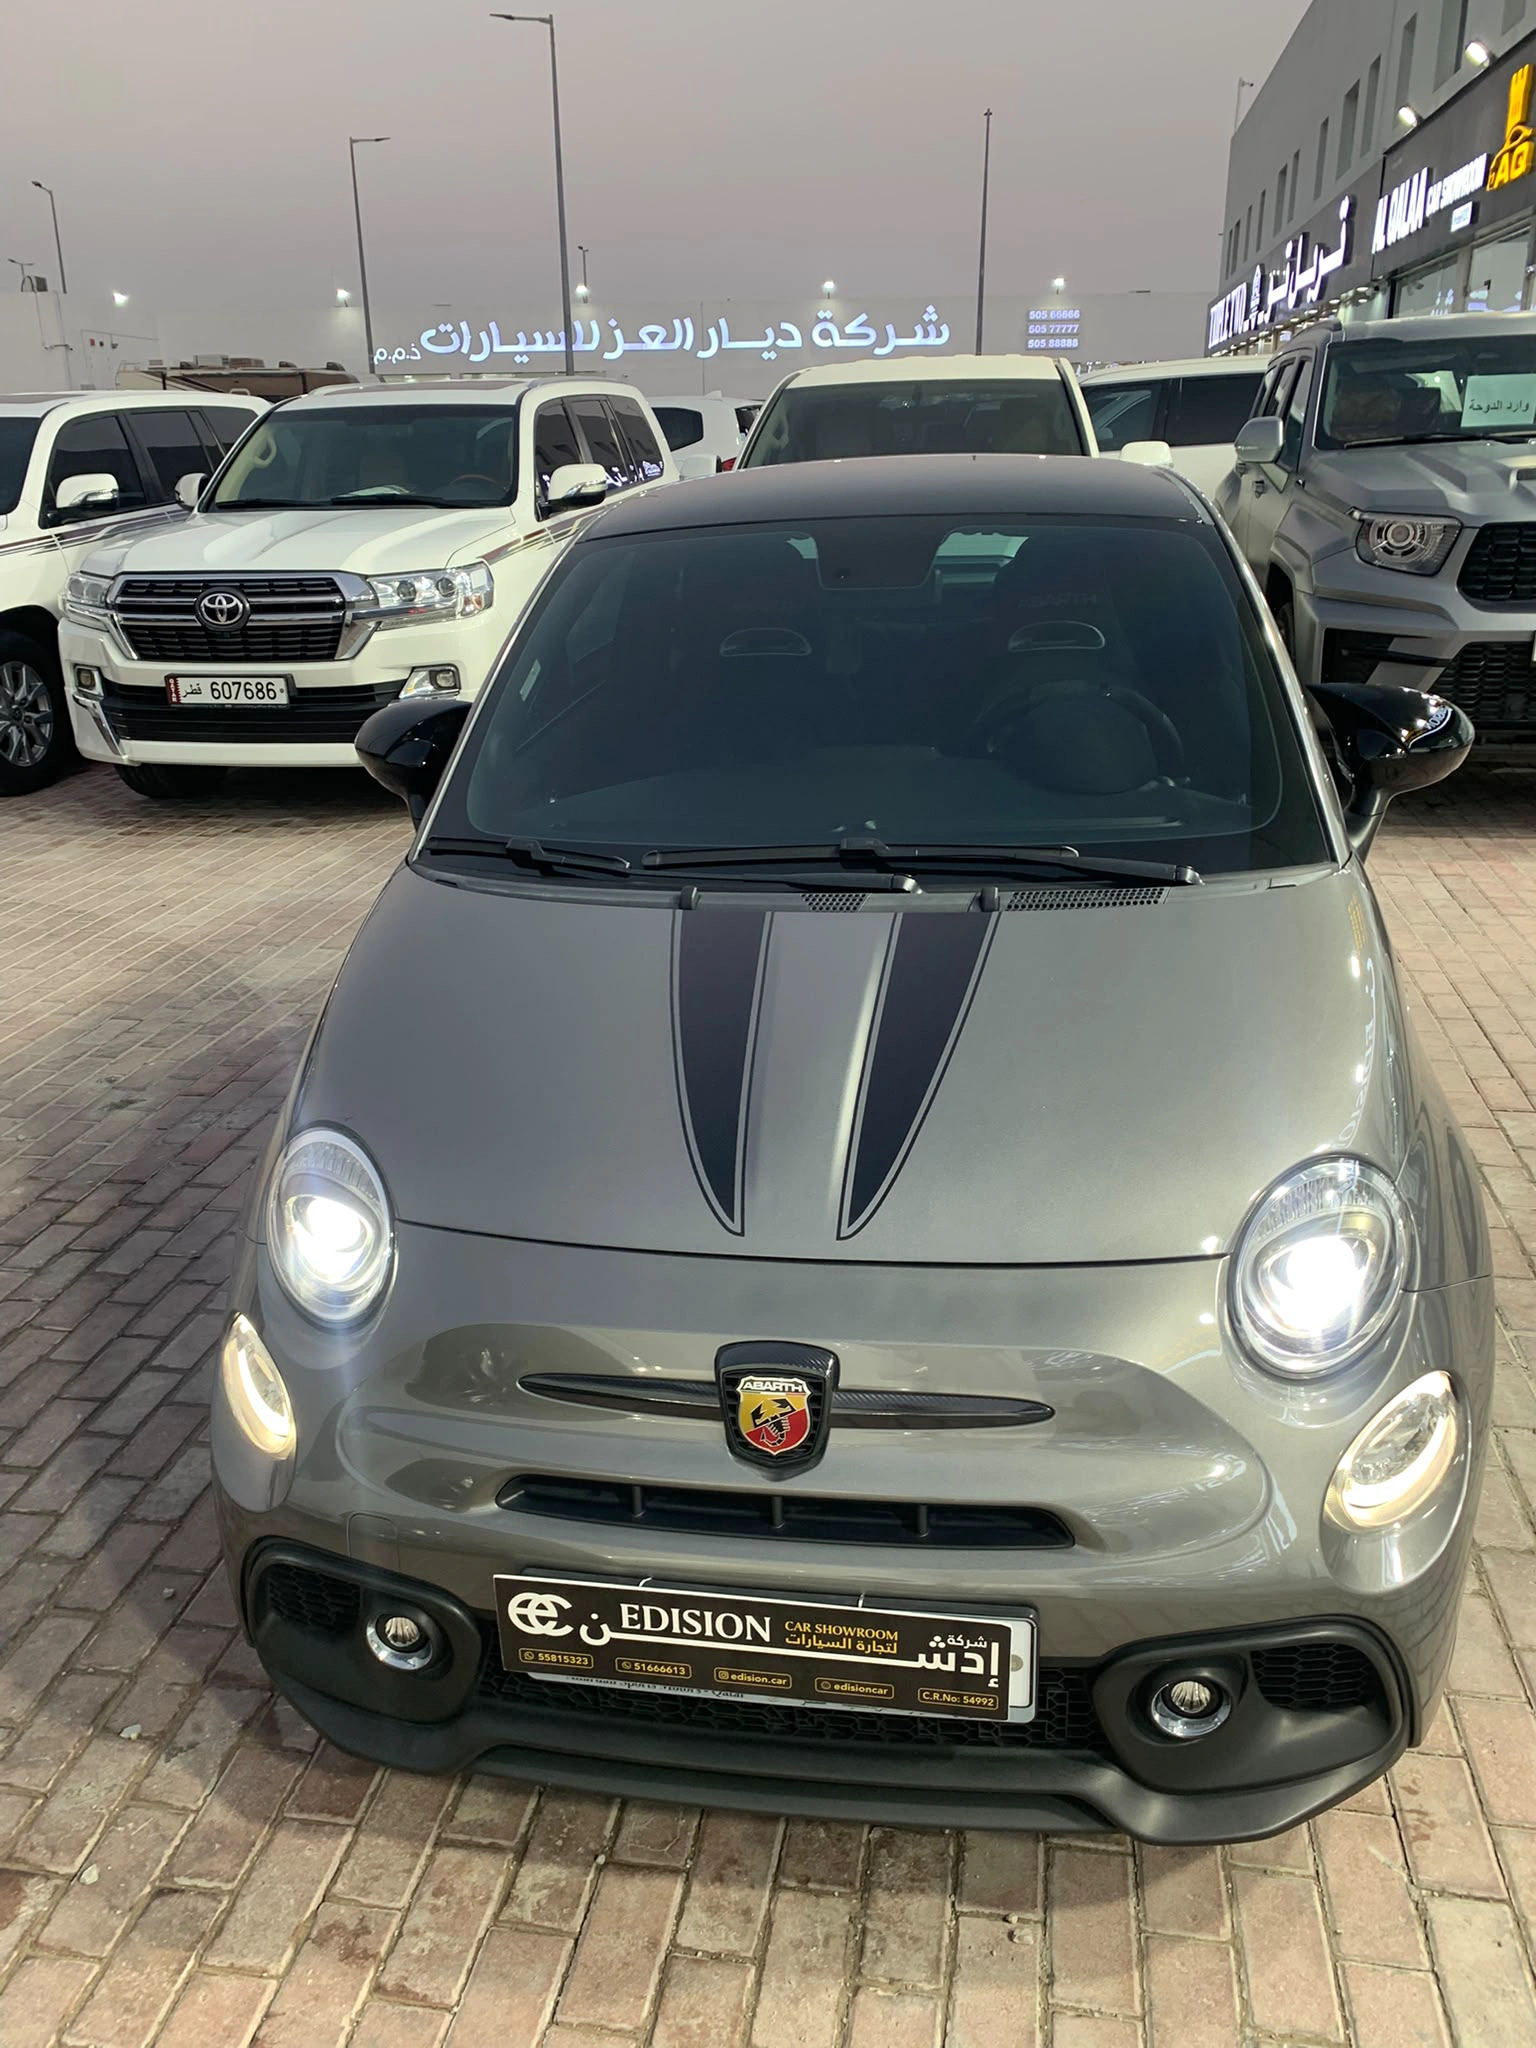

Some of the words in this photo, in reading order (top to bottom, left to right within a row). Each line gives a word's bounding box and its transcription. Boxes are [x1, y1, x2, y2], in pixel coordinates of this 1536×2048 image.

[1029, 310, 1047, 319] 505
[811, 305, 950, 356] شركة
[1028, 324, 1047, 333] 505
[1049, 324, 1079, 333] 77777
[420, 319, 600, 364] للسيارات
[602, 316, 695, 361] العز
[696, 317, 803, 361] ديار
[1028, 339, 1046, 348] 505
[182, 683, 202, 698] قطر
[210, 682, 277, 700] 607686
[743, 1381, 803, 1393] ABARTH
[619, 1602, 771, 1643] EDISION
[784, 1620, 812, 1634] CAR
[814, 1623, 899, 1641] SHOWROOM
[785, 1633, 852, 1650] السيارات
[856, 1640, 898, 1655] لتجارة
[946, 1634, 988, 1650] شركة
[537, 1652, 589, 1666] 55815323
[634, 1662, 686, 1676] 51666613
[730, 1671, 788, 1685] edision.car
[833, 1681, 888, 1695] edisioncar
[922, 1691, 961, 1704] C.R.No:
[963, 1694, 995, 1707] 54992
